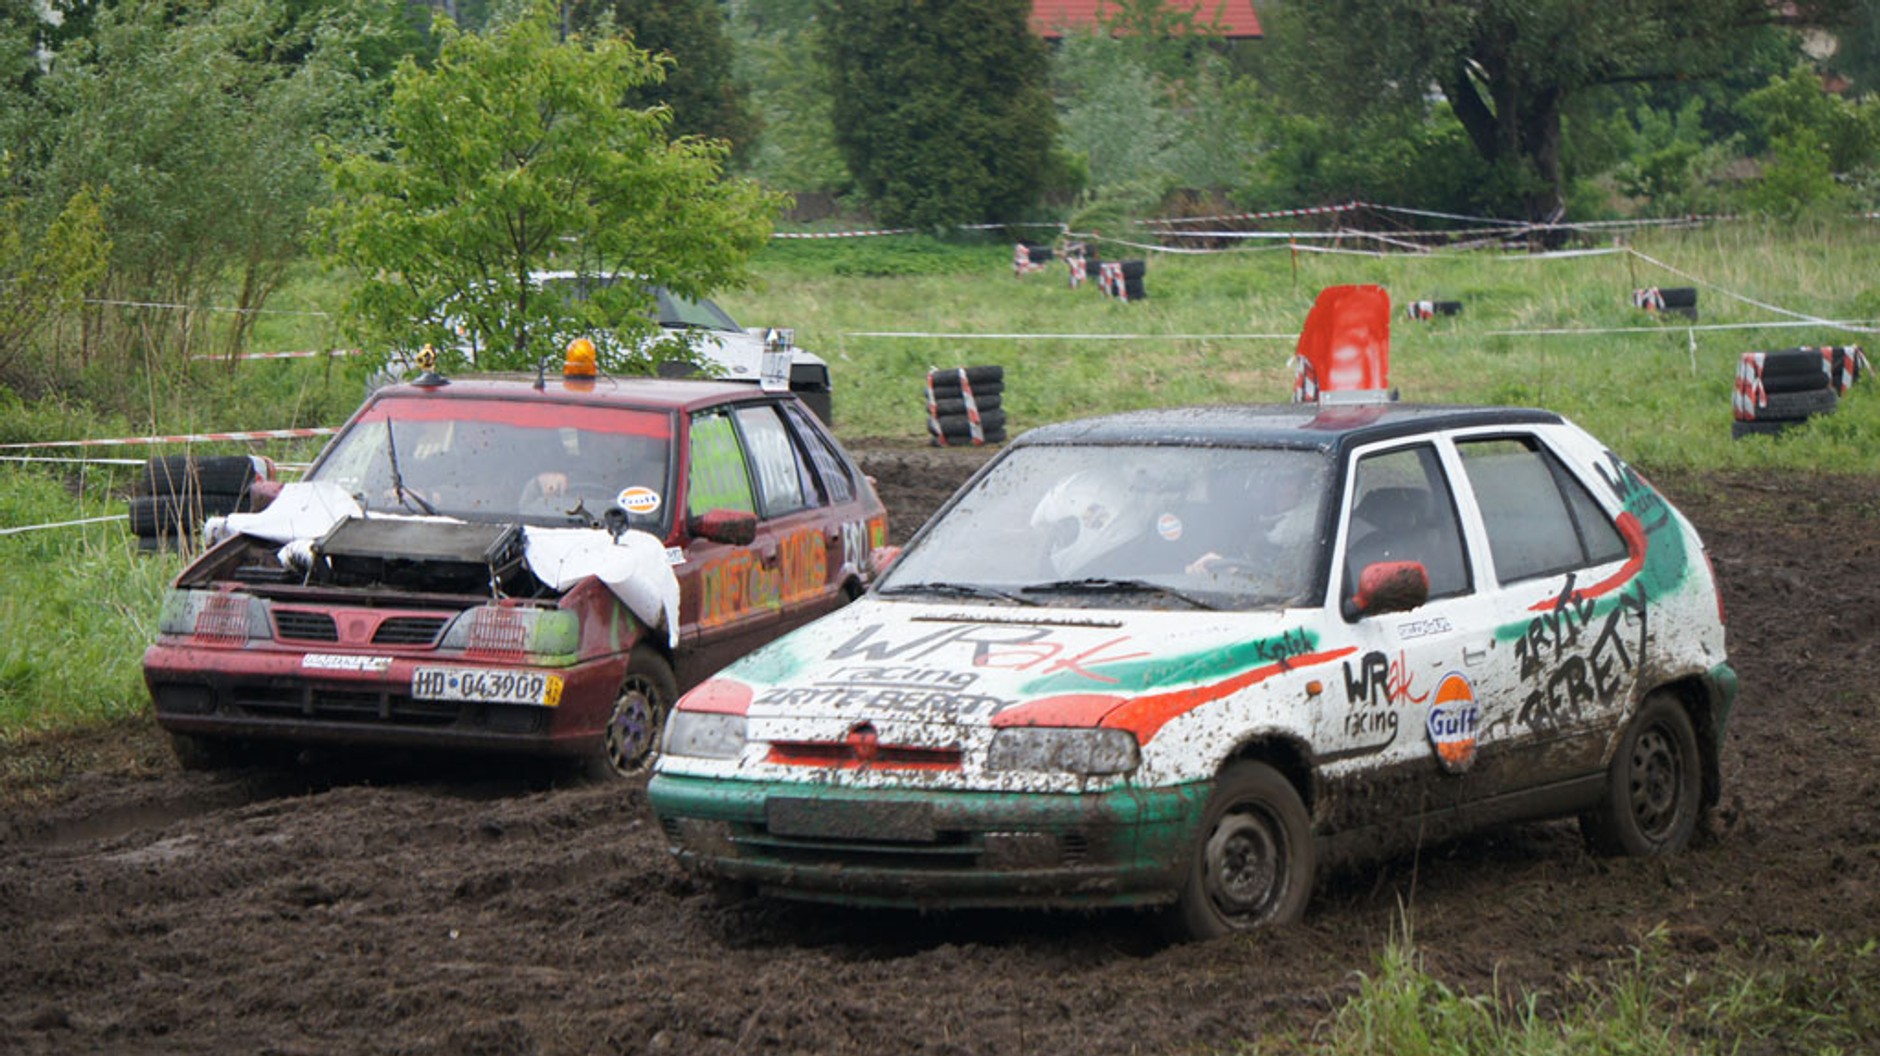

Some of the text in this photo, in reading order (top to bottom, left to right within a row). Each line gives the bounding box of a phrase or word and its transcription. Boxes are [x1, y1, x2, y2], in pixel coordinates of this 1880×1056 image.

[415, 671, 444, 697] HD
[459, 673, 543, 699] 043909
[828, 665, 980, 692] racing
[1342, 649, 1431, 707] WRak
[1344, 708, 1398, 744] racing
[1430, 707, 1478, 736] Gulf
